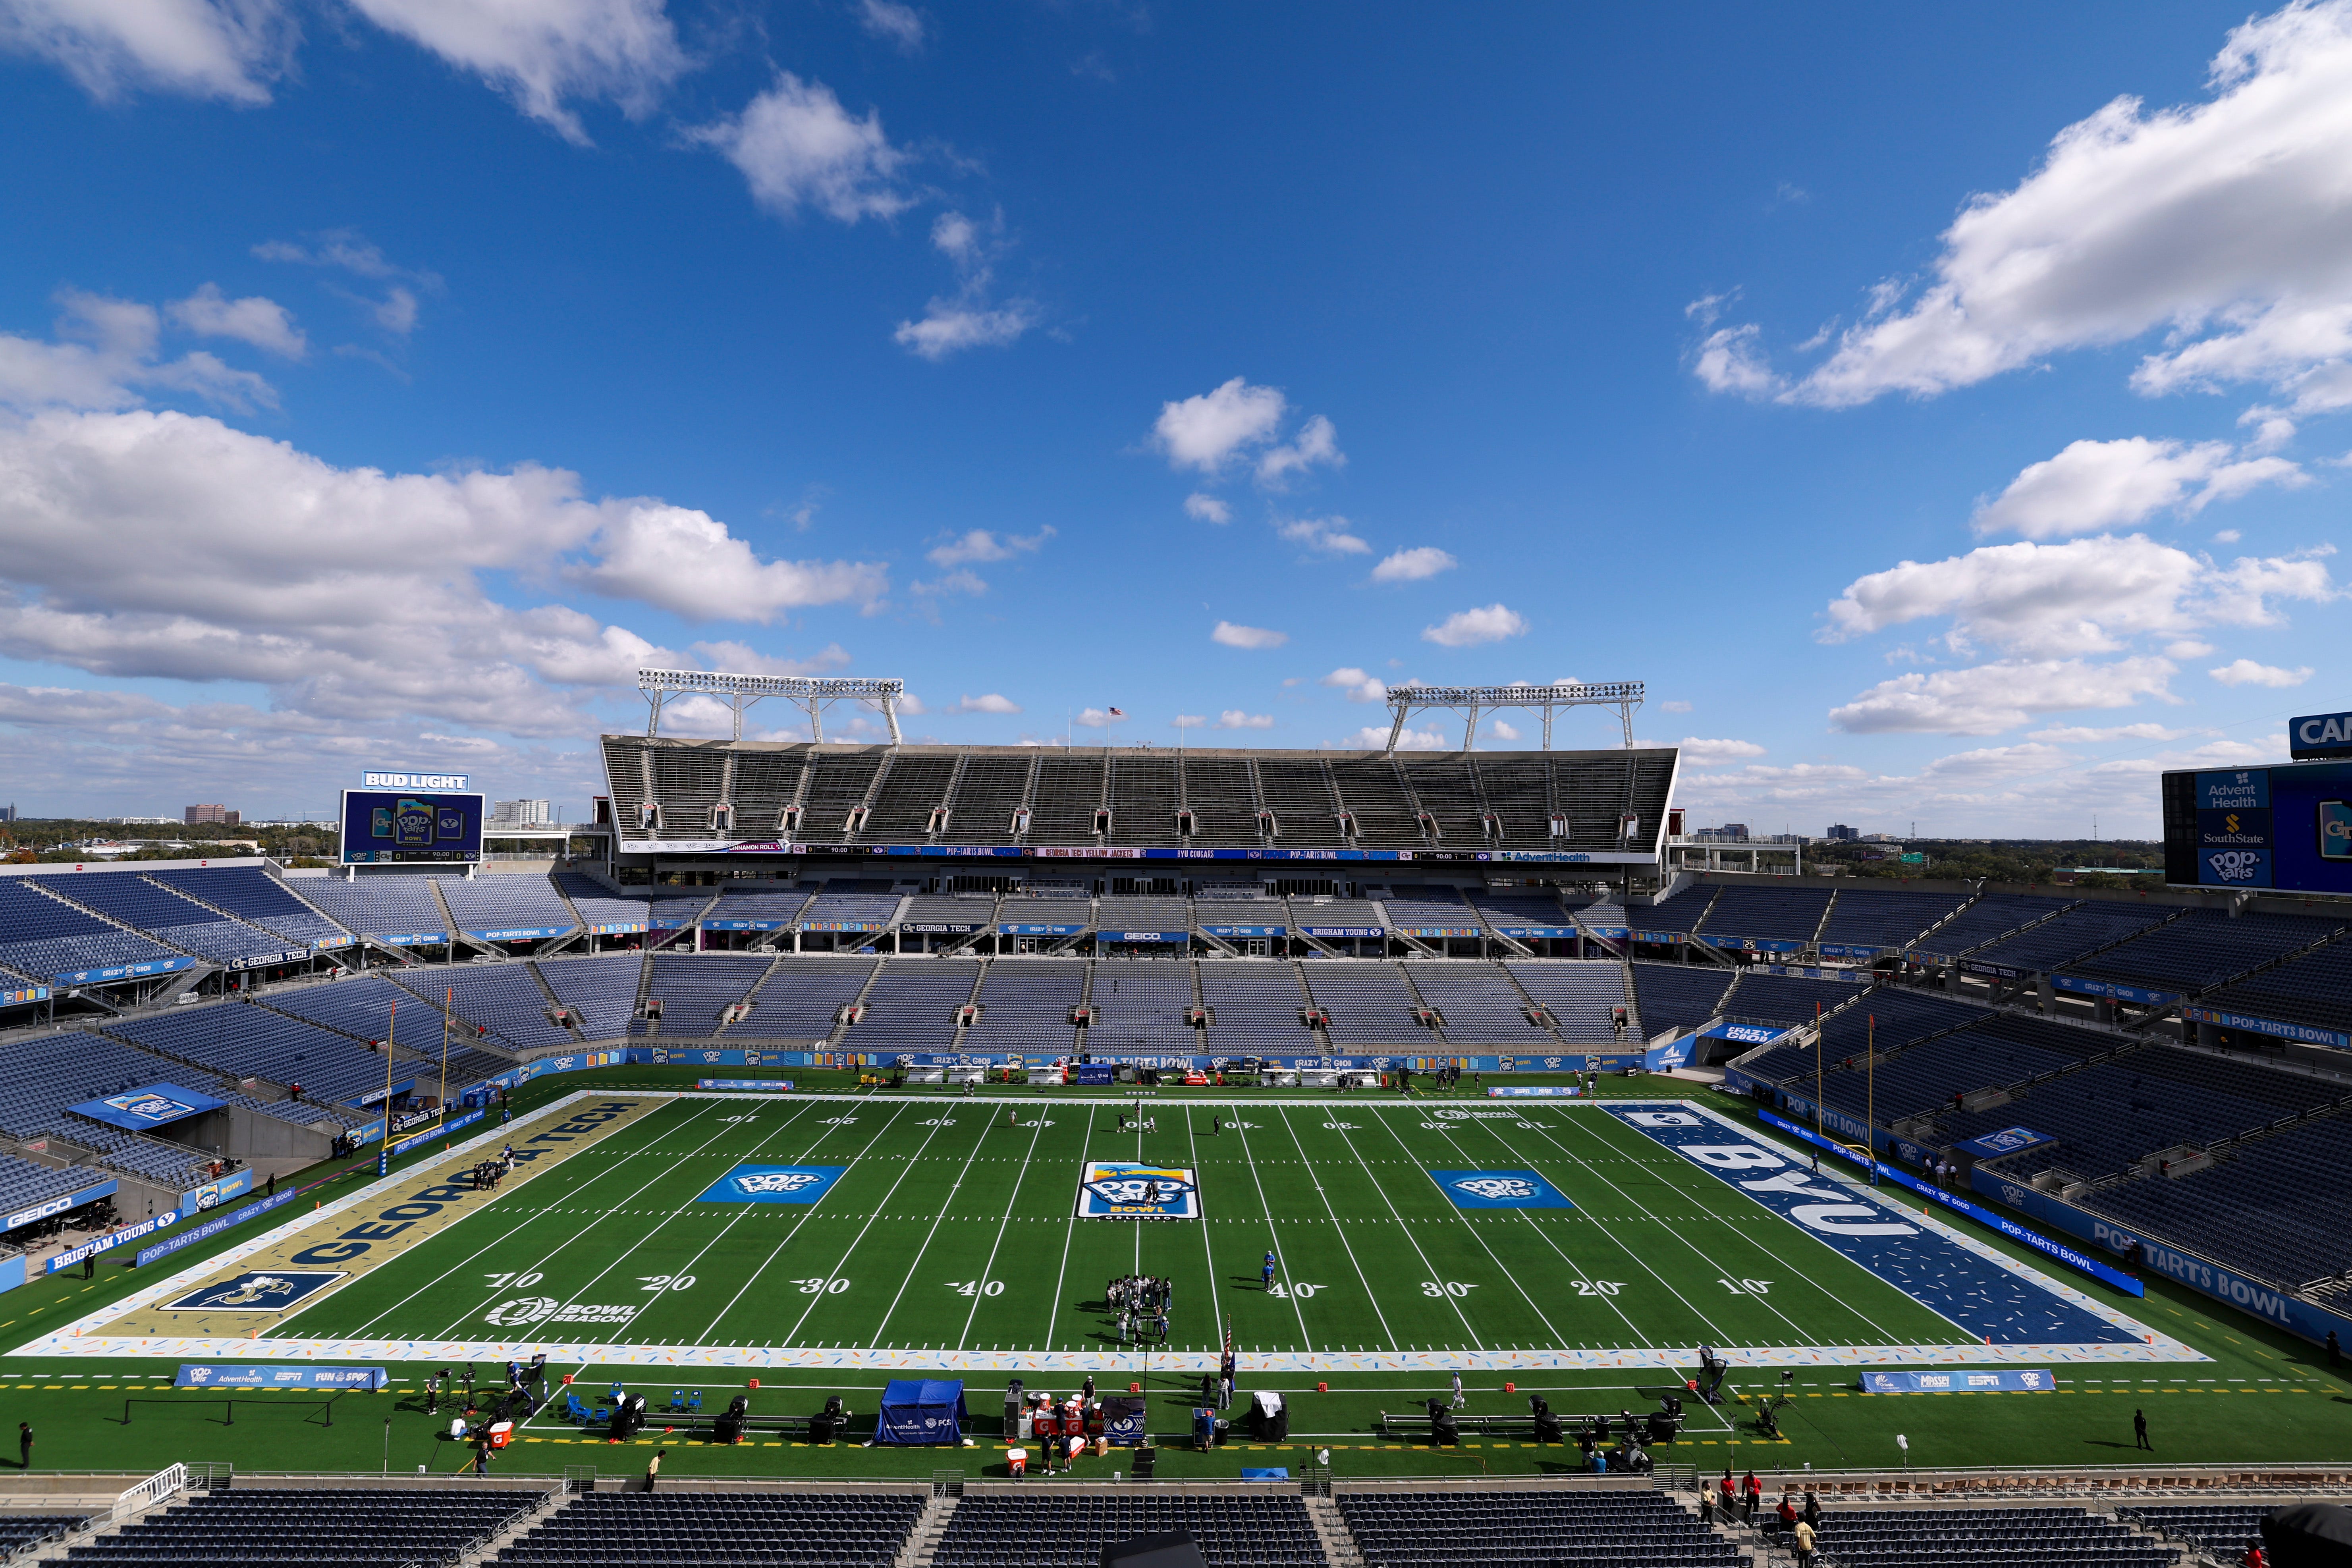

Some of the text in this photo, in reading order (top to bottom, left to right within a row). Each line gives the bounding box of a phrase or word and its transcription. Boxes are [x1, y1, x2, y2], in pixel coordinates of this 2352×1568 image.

[365, 773, 466, 789] BUD LIGHT
[2208, 785, 2256, 796] Advent
[2213, 797, 2256, 808] Health
[2204, 833, 2264, 844] SouthState
[1177, 850, 1214, 858] BYU COUGARS
[1515, 852, 1590, 862] AdventHealth
[2219, 867, 2254, 881] tarts
[248, 950, 307, 966] GEORGIA TECH
[1971, 964, 2016, 977] GEORGIA TECH
[2085, 983, 2133, 997] CRAZY GOOD
[1729, 1027, 1773, 1036] CRAZY
[2232, 1015, 2335, 1044] POP-TARTS BOWL
[1726, 1032, 1768, 1042] GOOD
[1091, 1057, 1194, 1068] POP-TARTS BOWL
[531, 1066, 541, 1074] BOWL
[362, 1087, 392, 1104] GEICO
[404, 1112, 429, 1128] GEORGIA
[451, 1120, 464, 1129] CRAZY
[525, 1102, 640, 1144] TECH
[1787, 1096, 1870, 1142] POP-TARTS BOWL
[1777, 1121, 1791, 1130] CRAZY
[364, 1126, 380, 1138] BOWL
[397, 1127, 446, 1152] POP-TARTS BOWL
[1833, 1144, 1869, 1166] POP-TARTS
[222, 1180, 243, 1195] BOWL
[1677, 1145, 1920, 1235] BYU
[1917, 1183, 1936, 1196] CRAZY
[276, 1190, 292, 1203] GOOD
[1952, 1198, 1970, 1210] GOOD
[8, 1197, 72, 1228] GEICO
[238, 1205, 260, 1220] CRAZY
[54, 1220, 155, 1270] BRIGHAM YOUNG
[143, 1219, 230, 1261] POP-TARTS BOWL
[2002, 1221, 2094, 1272] POP-TARTS BOWL
[2219, 1273, 2291, 1324] BOWL
[560, 1304, 637, 1315] BOWL
[551, 1315, 631, 1323] SEASON
[218, 1375, 262, 1383] AdventHealth
[275, 1372, 303, 1381] ESPN
[346, 1373, 369, 1382] SPOT
[563, 1375, 571, 1383] 20
[1921, 1375, 1949, 1385] MASSEY
[1968, 1375, 1999, 1385] ESPN
[750, 1380, 758, 1388] 30
[1040, 1421, 1049, 1431] G
[1069, 1421, 1079, 1432] G
[493, 1434, 502, 1444] G
